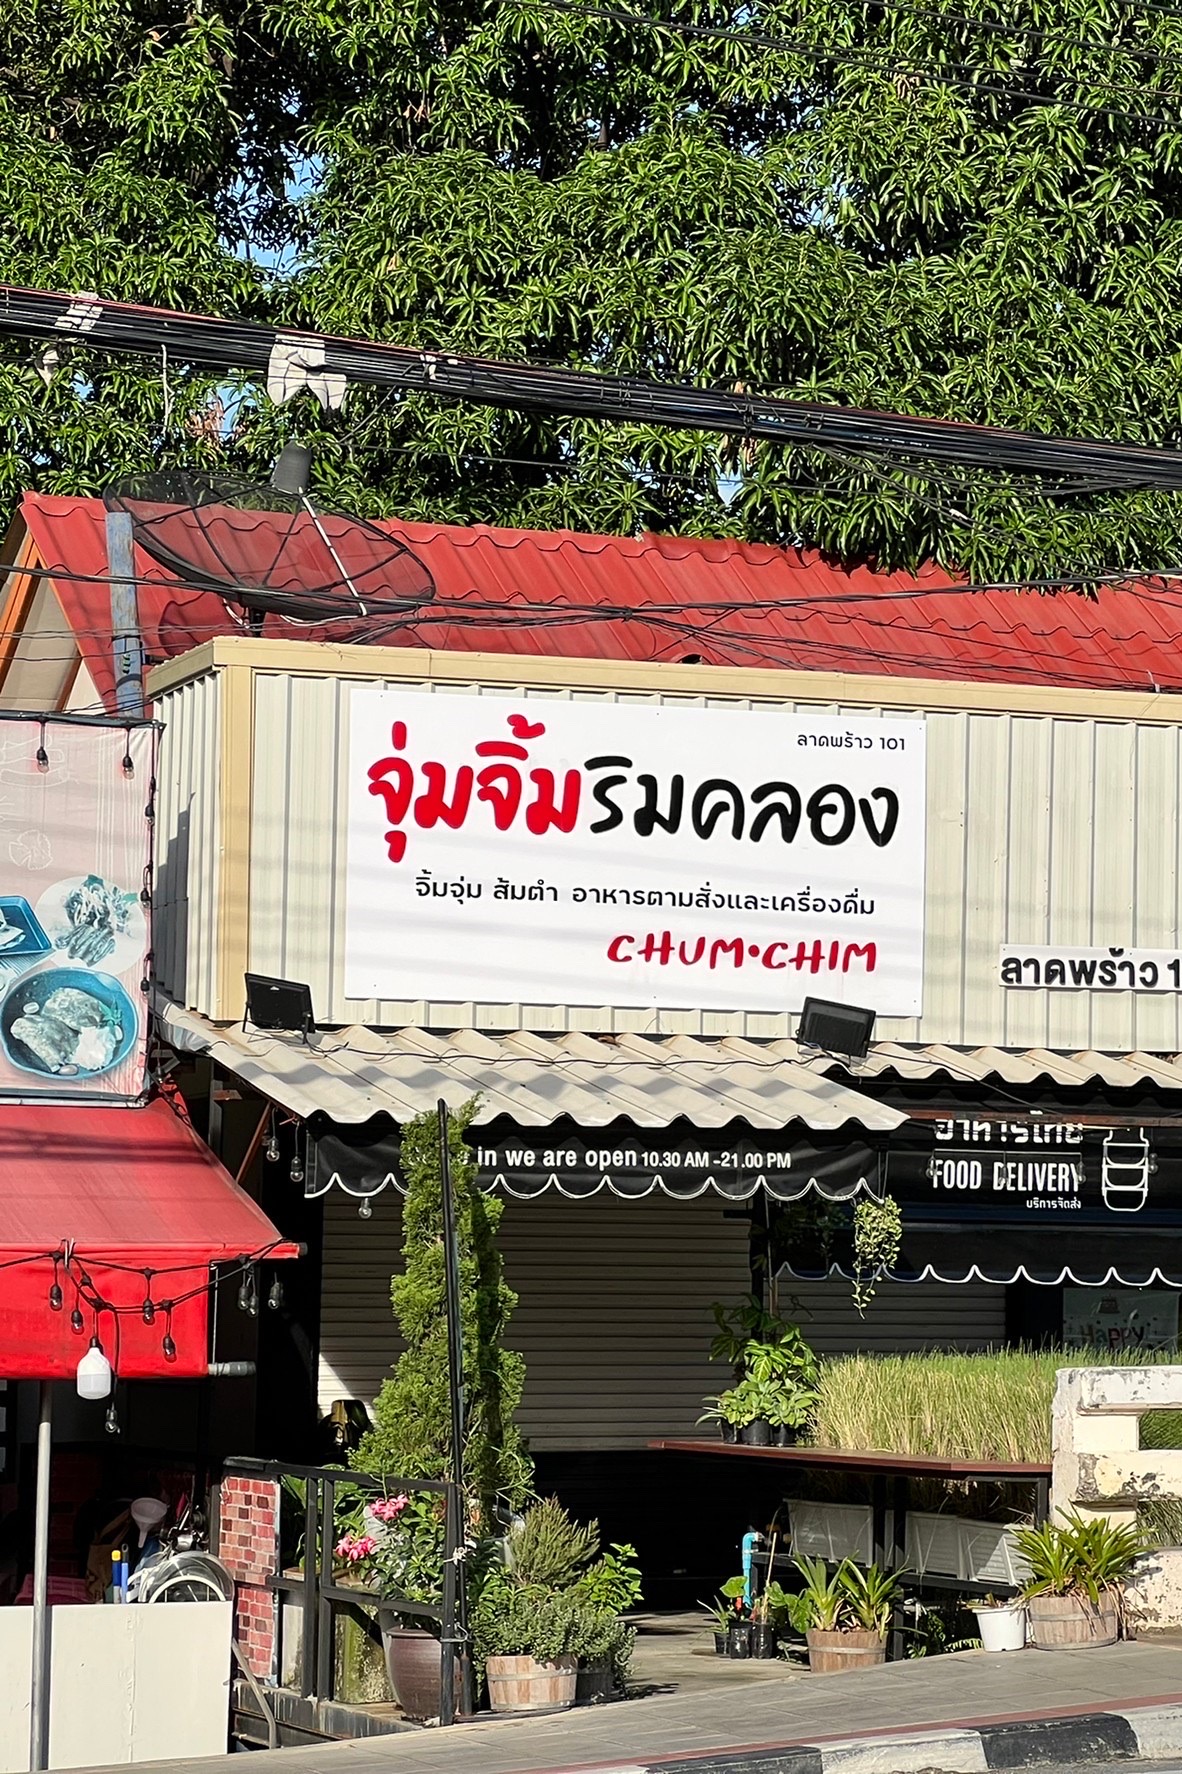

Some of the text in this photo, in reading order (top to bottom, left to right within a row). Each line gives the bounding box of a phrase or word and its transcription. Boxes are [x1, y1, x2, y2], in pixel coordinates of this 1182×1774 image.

[796, 731, 906, 751] ลาดพร้าว 101
[367, 714, 900, 863] จุ่มจิ้มริมคลอง
[415, 869, 875, 915] จิ้มจุ่ม ส้มตำ อาหารตามสั่งและเครื่องดื่ม
[1000, 948, 1159, 988] ลาดพร้าว
[478, 1146, 497, 1167] in
[505, 1150, 535, 1167] we
[543, 1150, 577, 1167] are
[585, 1149, 638, 1172] open
[642, 1151, 680, 1168] 10.30
[684, 1152, 710, 1168] AM
[767, 1153, 792, 1169] PM
[932, 1160, 1080, 1192] FOOD DELIVERY
[1026, 1196, 1082, 1210] บริการจัดส่ง
